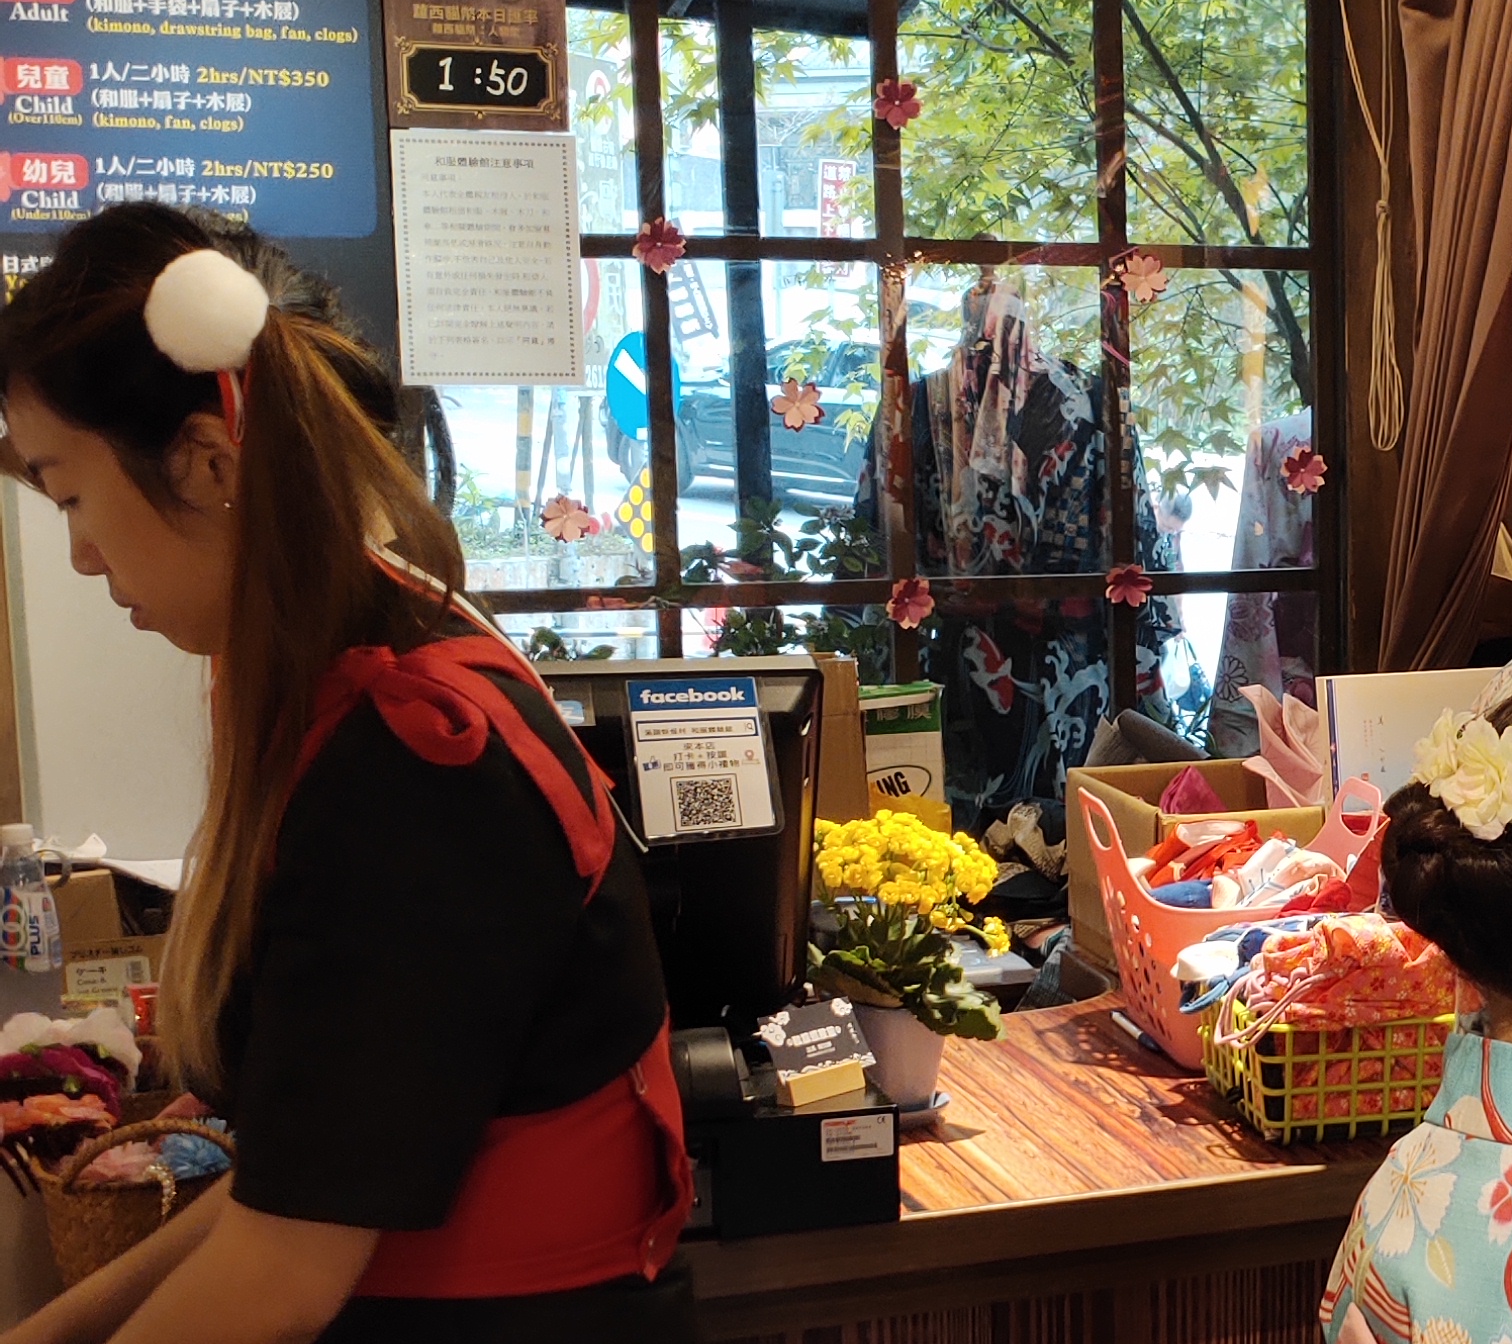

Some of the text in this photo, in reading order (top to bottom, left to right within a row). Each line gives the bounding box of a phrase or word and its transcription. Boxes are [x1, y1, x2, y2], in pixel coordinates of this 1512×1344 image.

[9, 2, 69, 22] Adult
[87, 16, 358, 44] (kimono, drawstring bag, fan, clogs)
[17, 64, 70, 90] 兒童
[90, 60, 330, 88] 1人/二小時 2hrs/NT$350
[15, 96, 74, 114] Child
[92, 111, 244, 133] (kimono, fan, clogs)
[23, 159, 76, 185] 幼兒
[95, 155, 335, 180] 1人/二小時 2hrs/NT$250
[21, 190, 79, 209] Child
[639, 686, 746, 704] facebook
[876, 771, 912, 798] ING
[29, 914, 41, 956] PLUS
